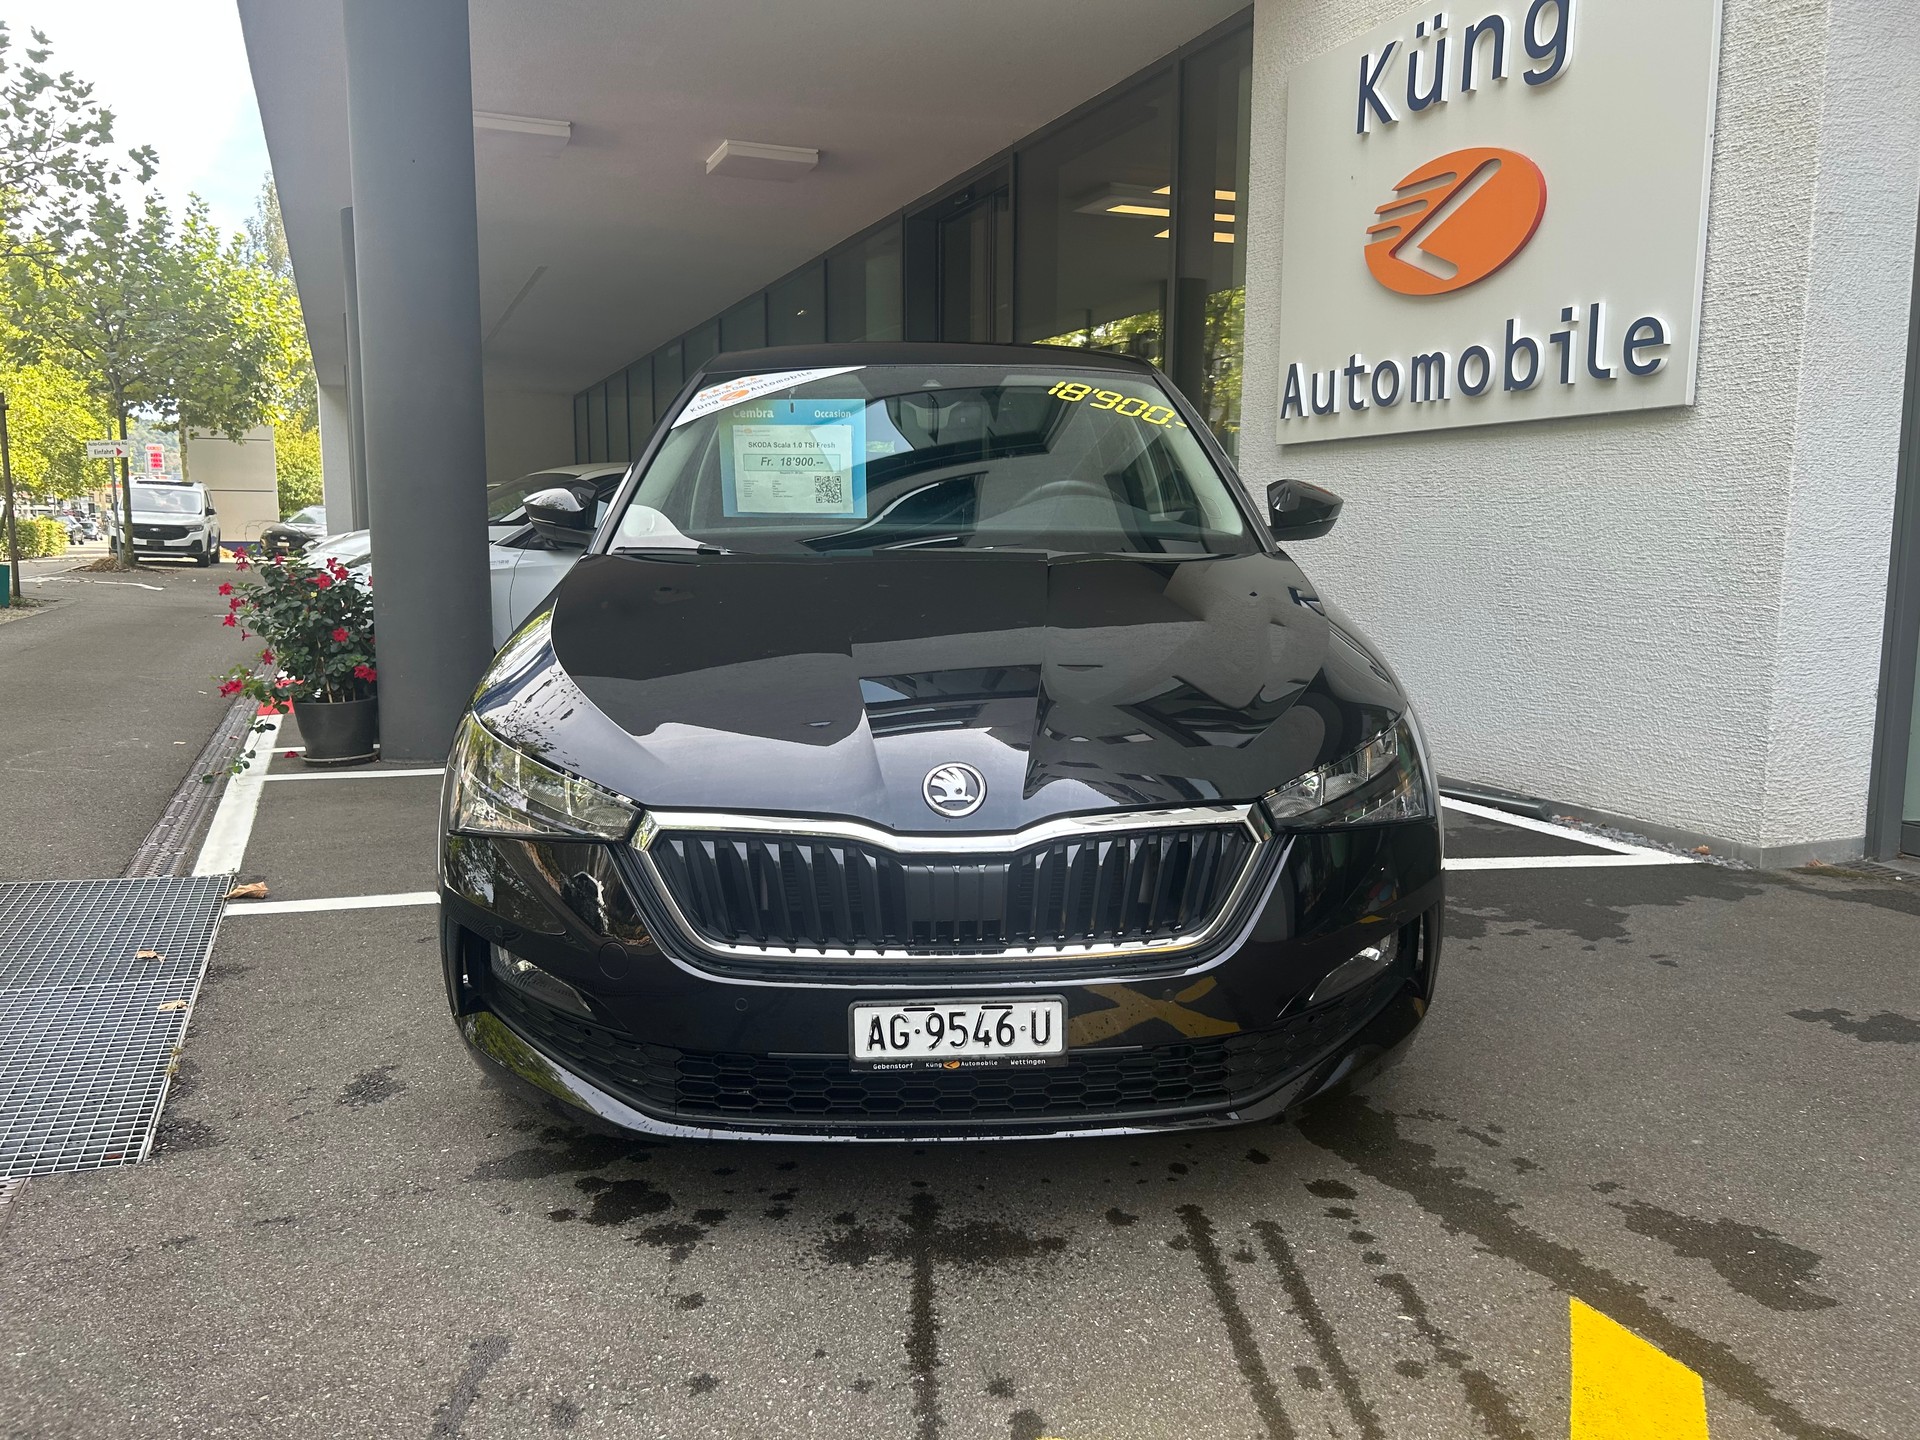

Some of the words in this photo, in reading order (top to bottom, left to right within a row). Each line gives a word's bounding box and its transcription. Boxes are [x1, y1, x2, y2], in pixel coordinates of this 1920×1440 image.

[1356, 0, 1575, 135] Küng
[1280, 303, 1671, 420] Automobile
[690, 399, 719, 413] Küng
[750, 371, 813, 392] Automobile
[733, 408, 774, 418] Cembra
[814, 410, 851, 418] Occasion
[760, 457, 774, 466] Fr.
[872, 1062, 914, 1070] Gebenstorf
[1010, 1058, 1046, 1066] Wettingen
